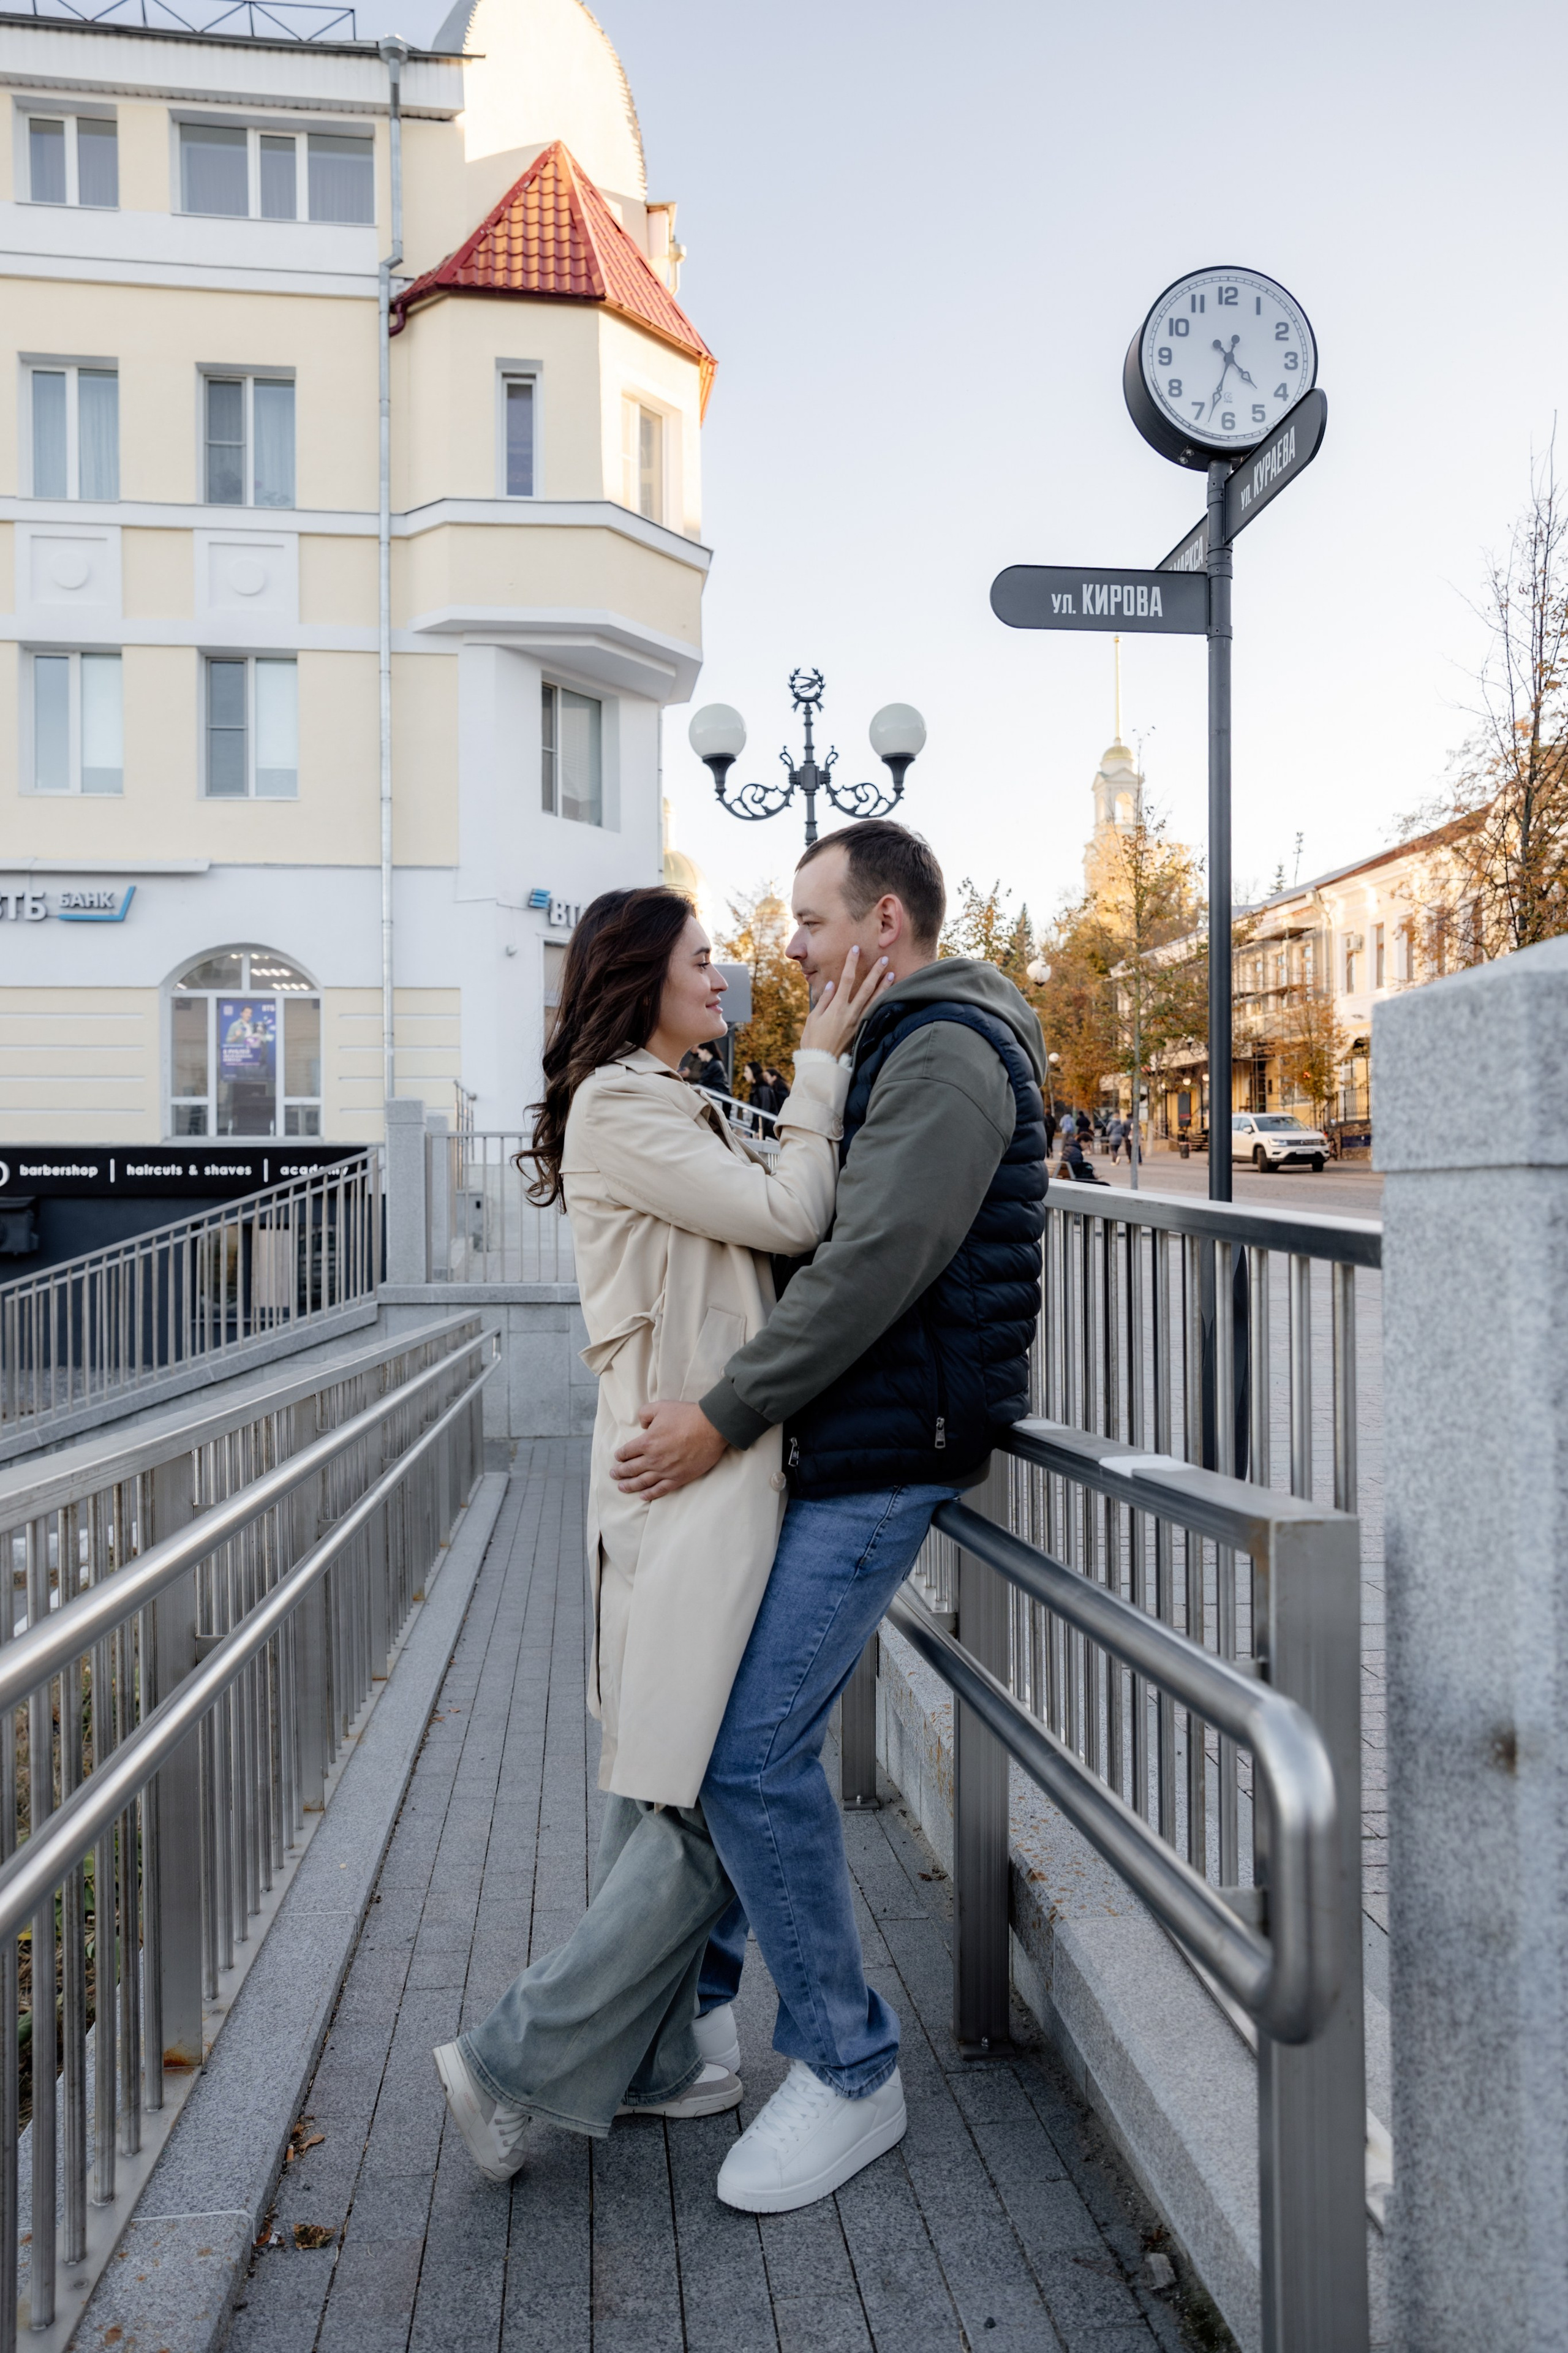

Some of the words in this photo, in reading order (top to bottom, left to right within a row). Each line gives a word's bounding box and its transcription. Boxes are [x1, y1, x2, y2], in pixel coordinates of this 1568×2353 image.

[1191, 294, 1205, 313] 11
[1218, 286, 1238, 306] 12
[1256, 296, 1261, 315] 1
[1169, 317, 1189, 337] 10
[1275, 322, 1289, 341] 2
[1158, 347, 1172, 366] 9
[1284, 352, 1298, 370] 3
[1168, 379, 1182, 398] 8
[1273, 383, 1289, 401] 4
[1191, 402, 1205, 420] 7
[1251, 404, 1266, 423] 5
[1221, 412, 1235, 430] 6
[1254, 426, 1295, 498] КУРАЕВА
[1082, 584, 1163, 617] КИРОВА
[0, 891, 47, 921] ТБ
[59, 891, 115, 908] БАНК
[550, 898, 586, 927] ВТ
[20, 1163, 99, 1178] barbershop
[126, 1163, 183, 1176] haircuts
[189, 1164, 198, 1176] &
[204, 1163, 252, 1176] shaves
